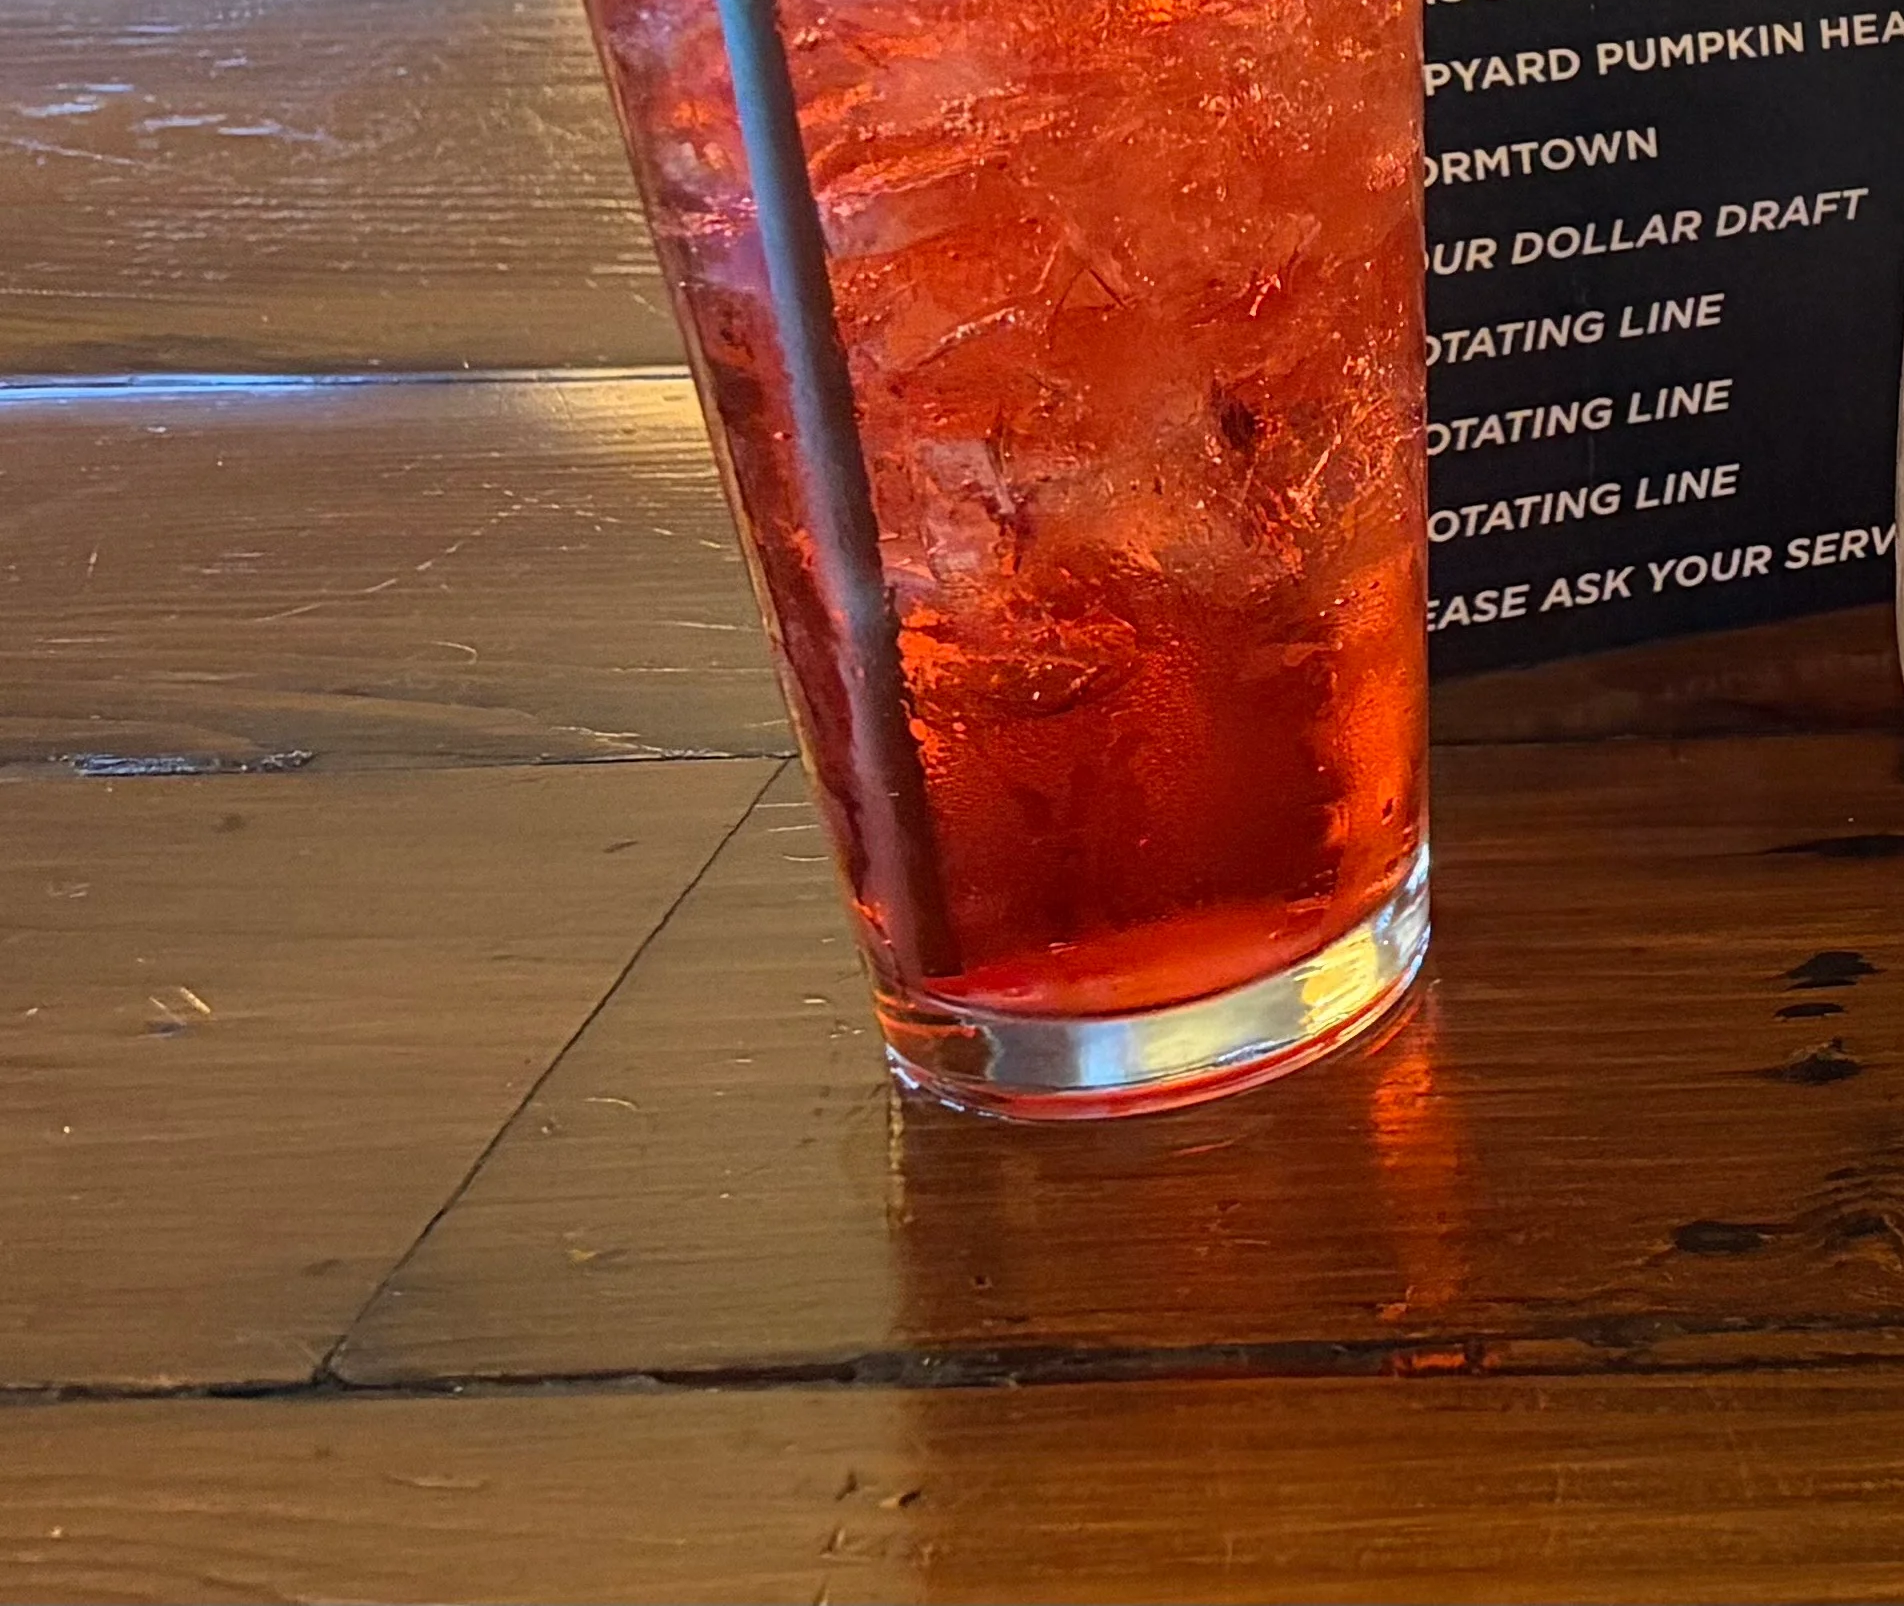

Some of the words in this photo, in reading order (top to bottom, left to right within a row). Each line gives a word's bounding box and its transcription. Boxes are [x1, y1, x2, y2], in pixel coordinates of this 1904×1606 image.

[1596, 21, 1804, 75] PUMPKIN
[1511, 210, 1702, 265] DOLLAR
[1715, 187, 1869, 237] DRAFT
[1428, 482, 1621, 543] OTATING
[1635, 463, 1740, 510] LINE
[1539, 565, 1635, 612] ASK
[1647, 544, 1773, 593] YOUR
